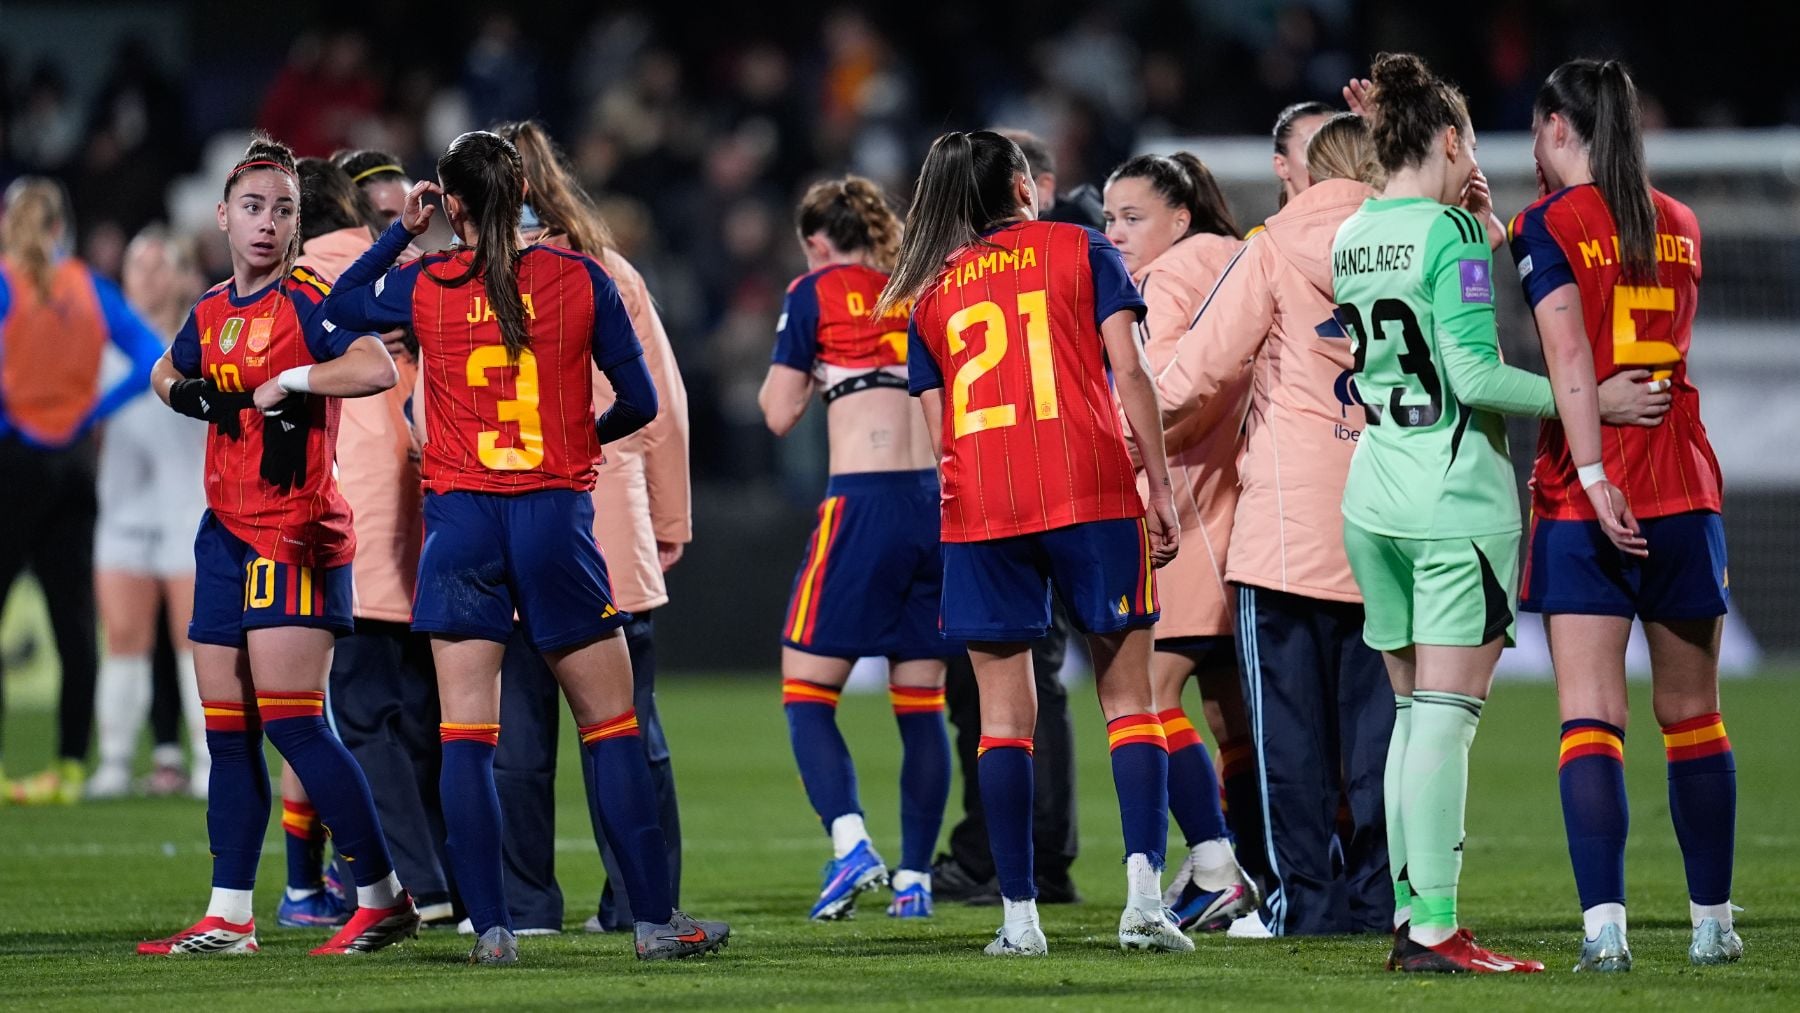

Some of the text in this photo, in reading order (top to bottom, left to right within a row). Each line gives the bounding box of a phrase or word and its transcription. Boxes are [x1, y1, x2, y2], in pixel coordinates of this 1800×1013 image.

[944, 247, 1037, 294] FIAMMA
[1333, 245, 1415, 278] NANCLARES
[1578, 233, 1697, 269] M. NDEZ
[466, 293, 536, 323] JAA
[210, 363, 245, 393] 10
[947, 290, 1059, 439] 21
[1336, 299, 1443, 428] 23
[466, 345, 544, 470] 3
